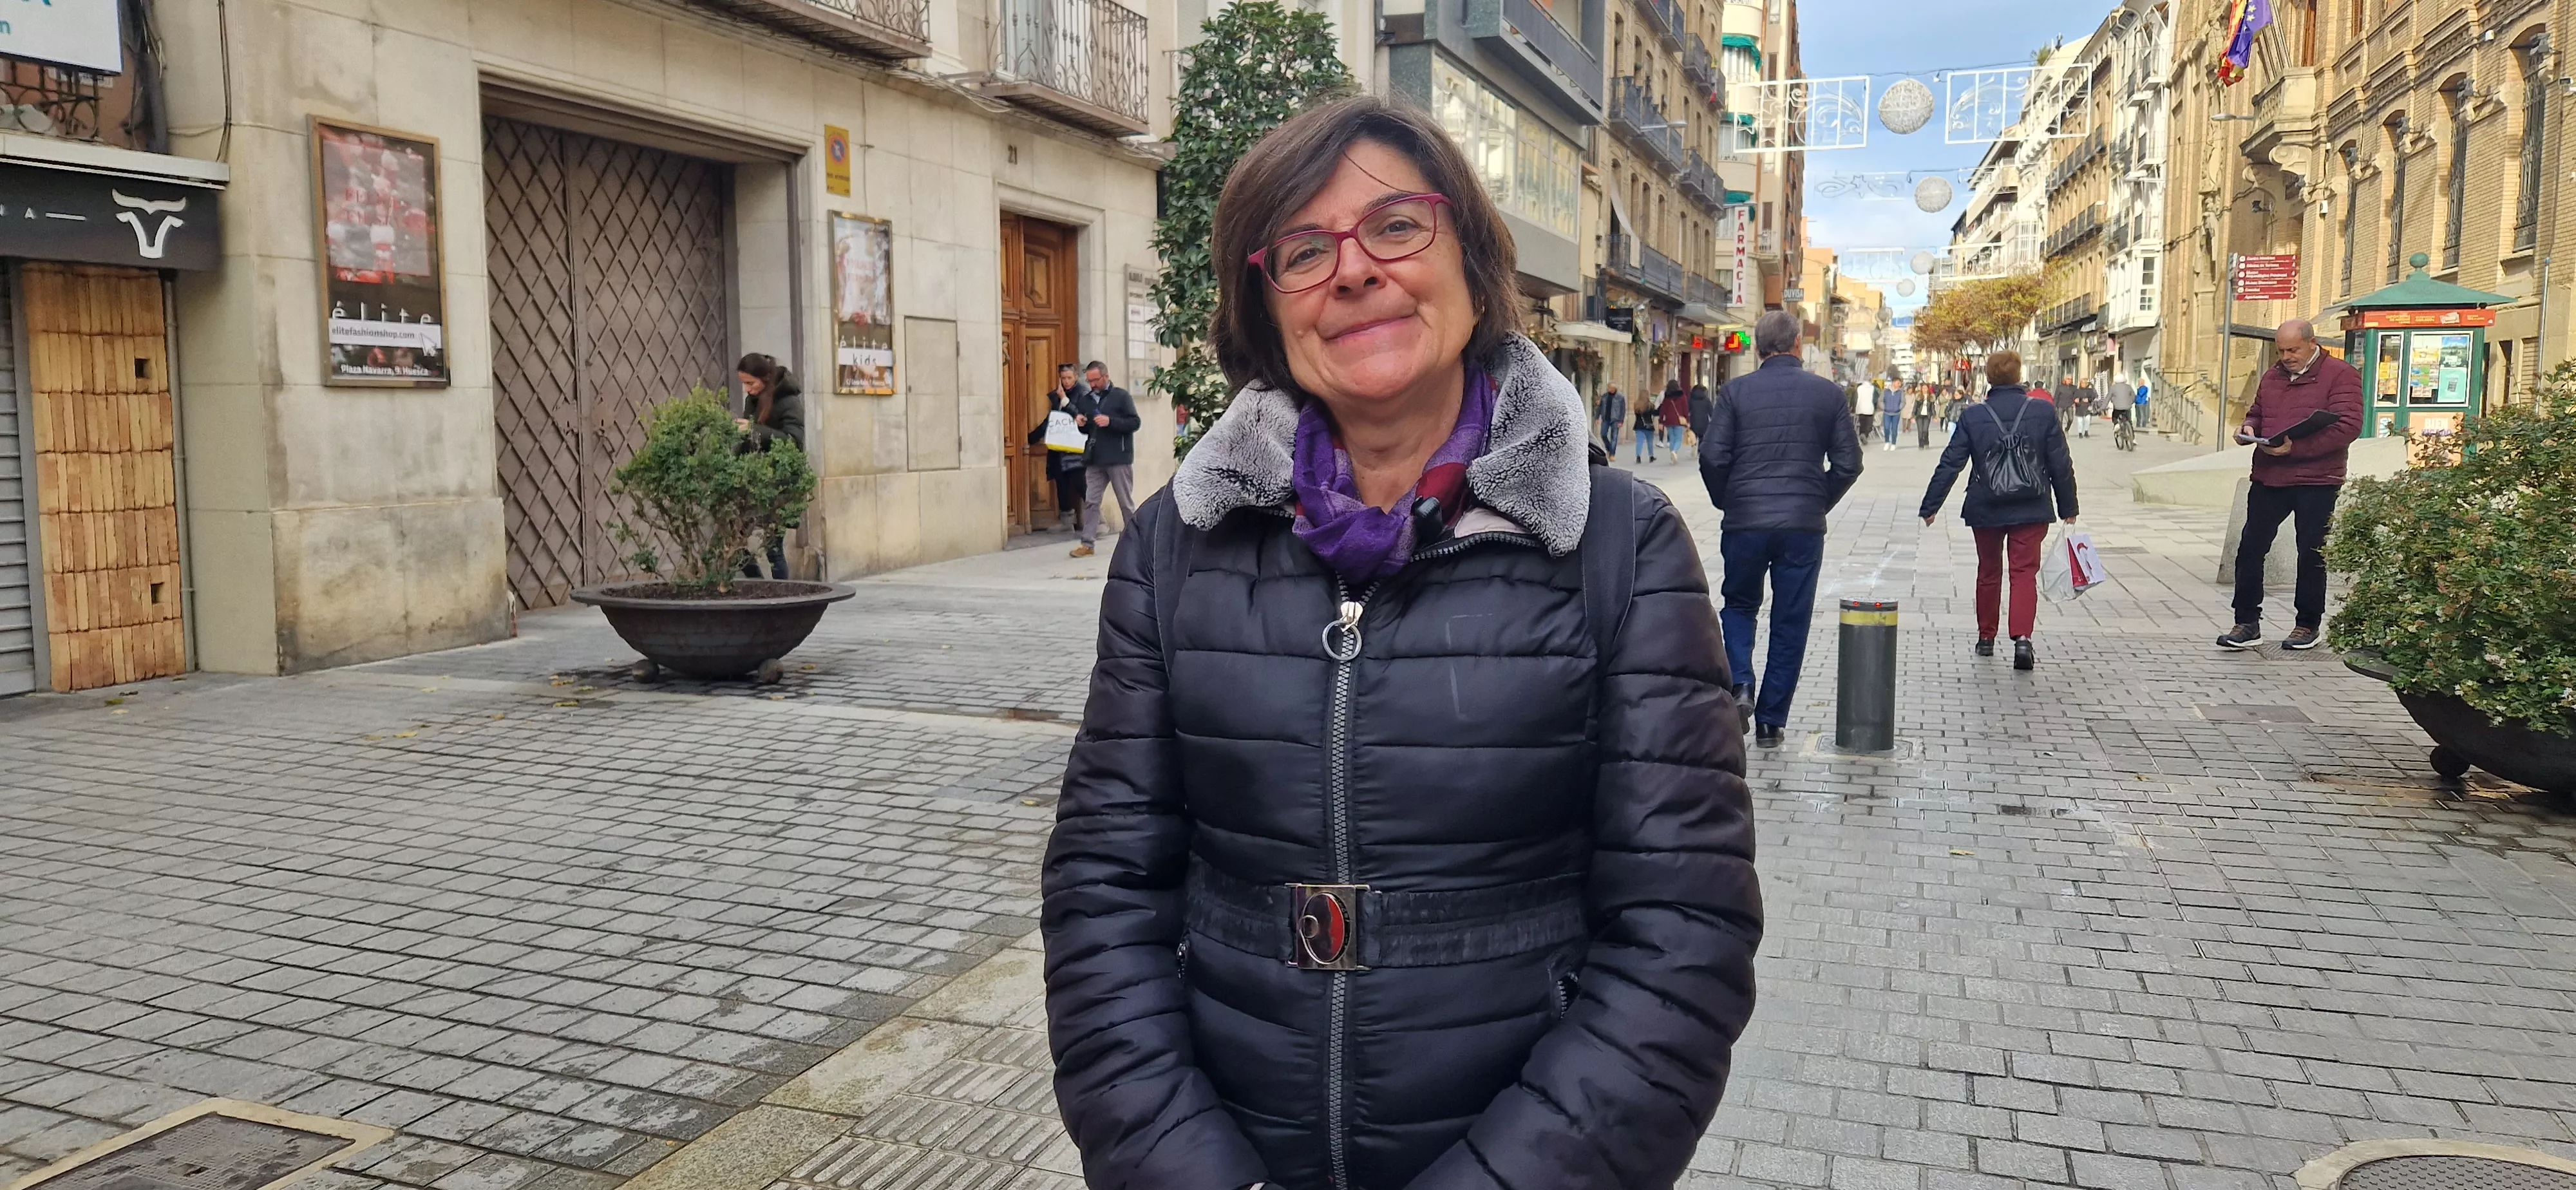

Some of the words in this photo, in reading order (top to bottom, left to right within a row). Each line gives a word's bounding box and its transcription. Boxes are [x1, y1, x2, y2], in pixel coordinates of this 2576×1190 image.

[1007, 144, 1018, 165] 21
[1736, 210, 1745, 304] FARMACIA
[1784, 289, 1803, 298] DUVISA
[332, 300, 432, 325] élite
[332, 325, 415, 339] elitefashionshop.com
[853, 353, 876, 366] kids
[341, 364, 362, 373] Plaza
